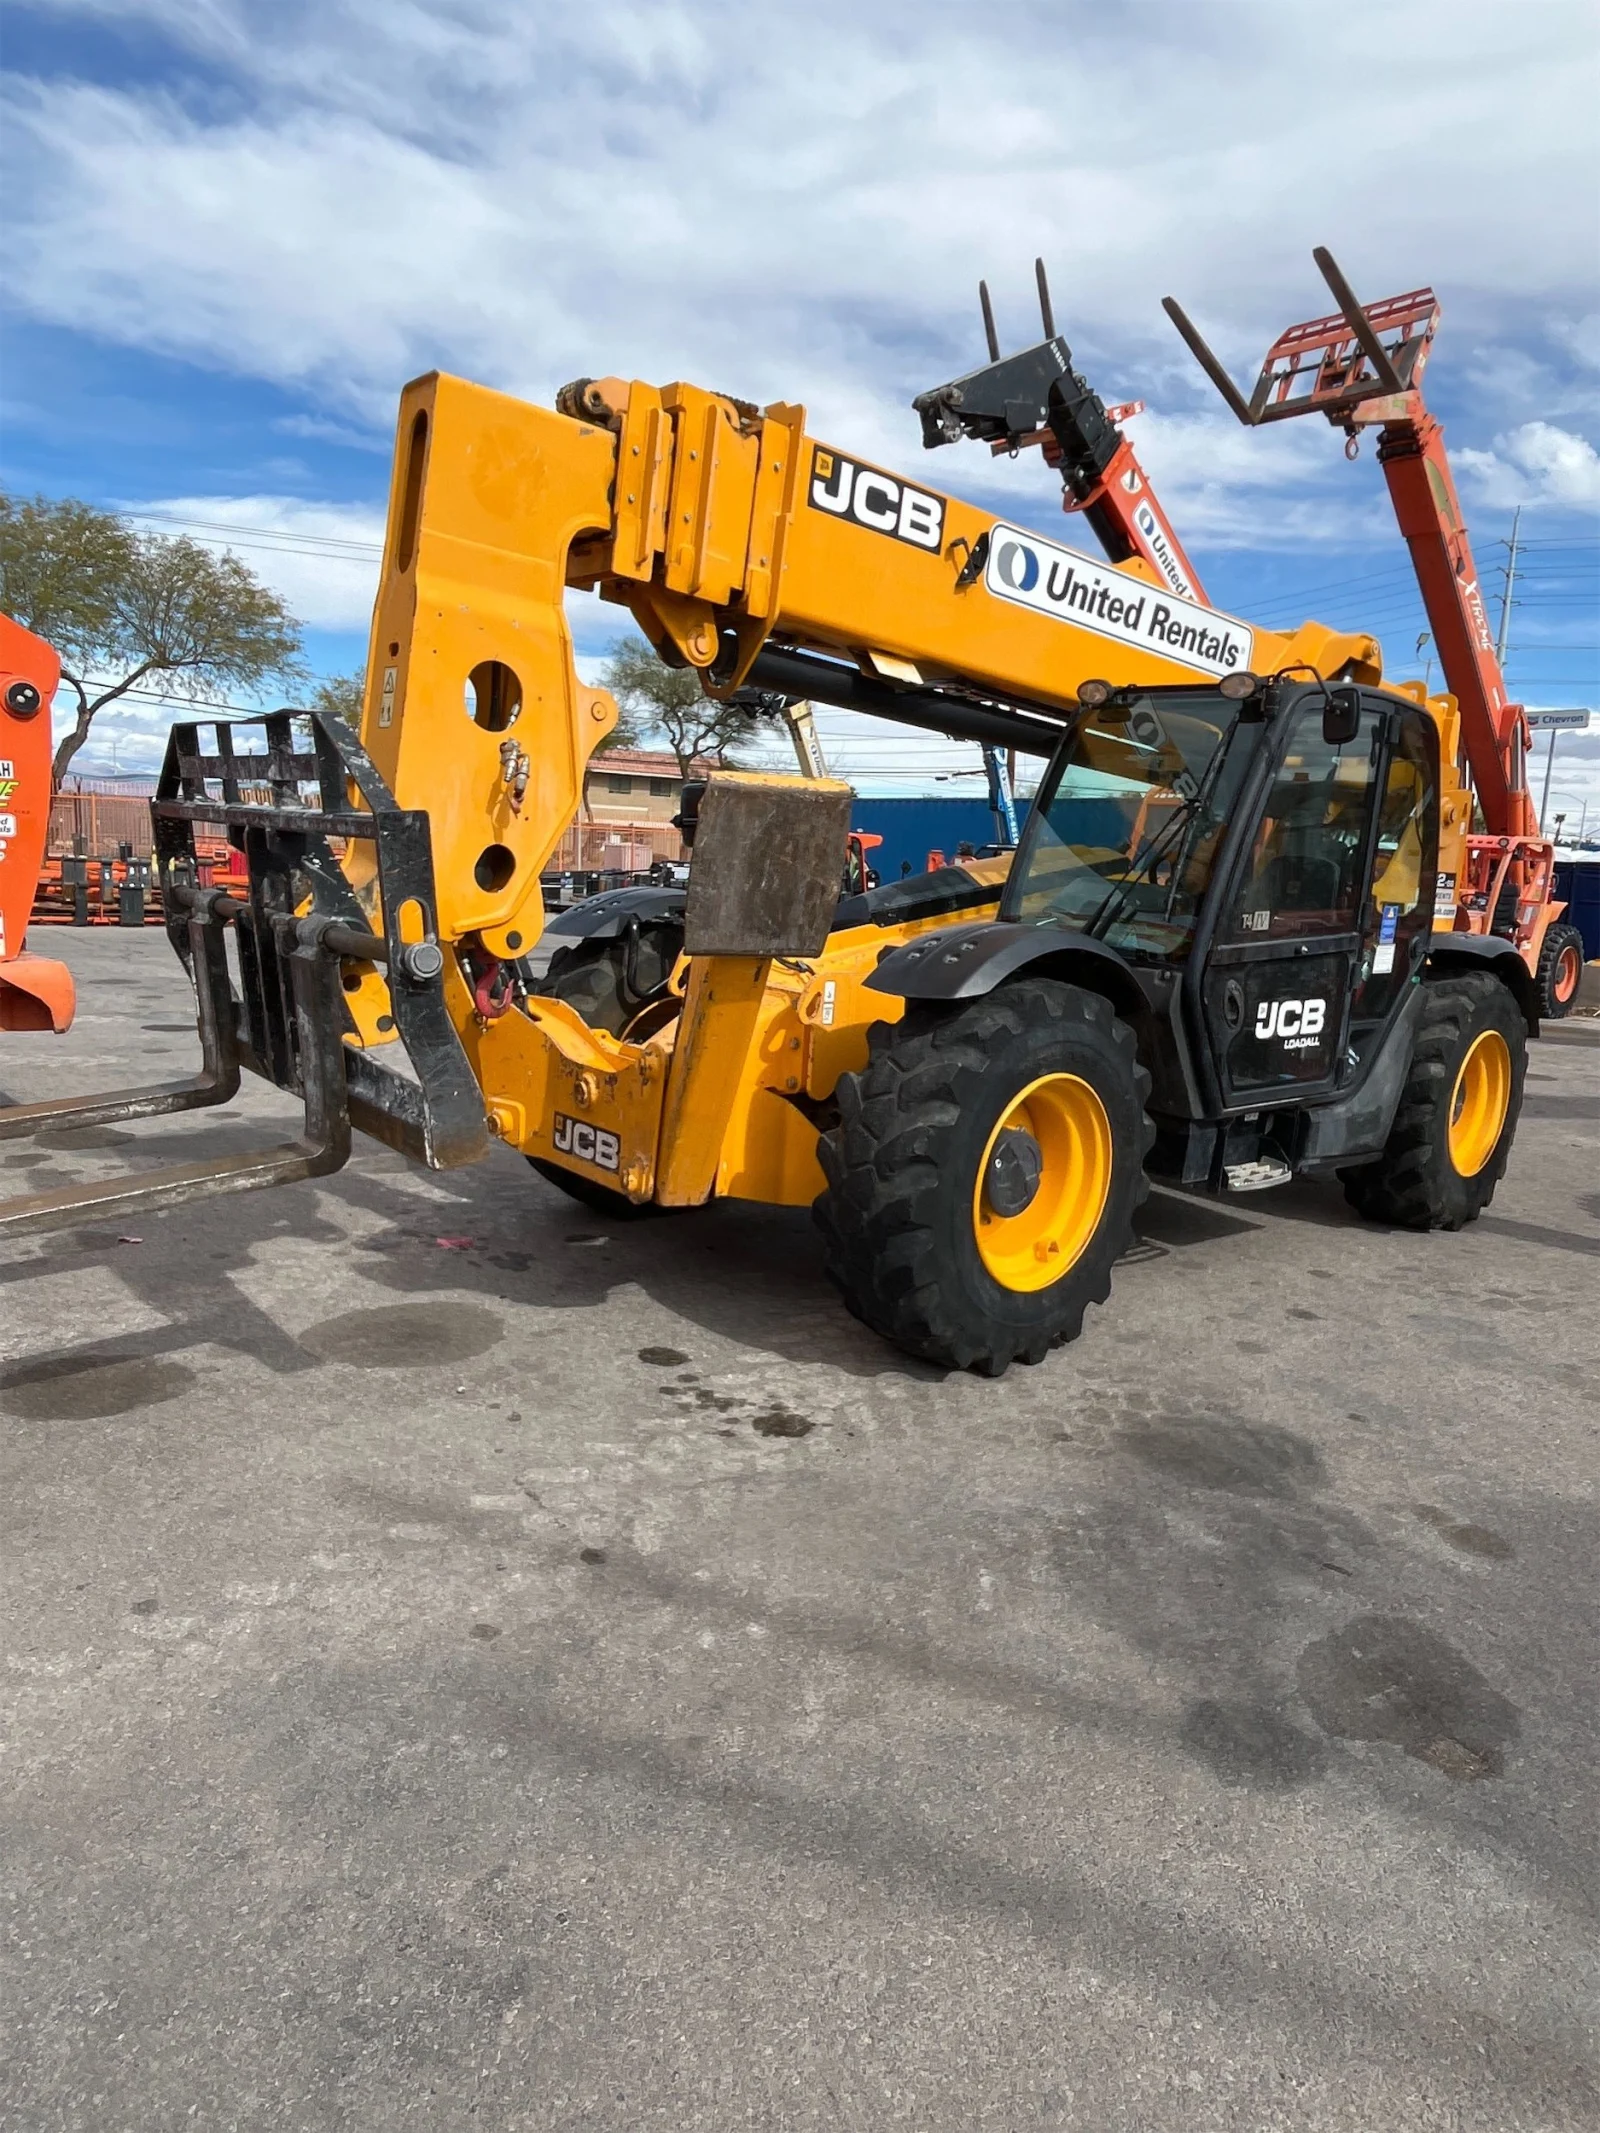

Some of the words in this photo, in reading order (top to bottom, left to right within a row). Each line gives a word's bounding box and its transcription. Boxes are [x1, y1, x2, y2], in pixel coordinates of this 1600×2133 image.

[812, 462, 943, 548] JCB
[1152, 535, 1188, 595] United
[1046, 561, 1146, 632] United
[1148, 604, 1240, 668] Rentals
[1542, 715, 1584, 724] Chevron
[1255, 999, 1327, 1039] JCB
[1284, 1036, 1320, 1050] LOADALL
[555, 1118, 618, 1169] JCB
